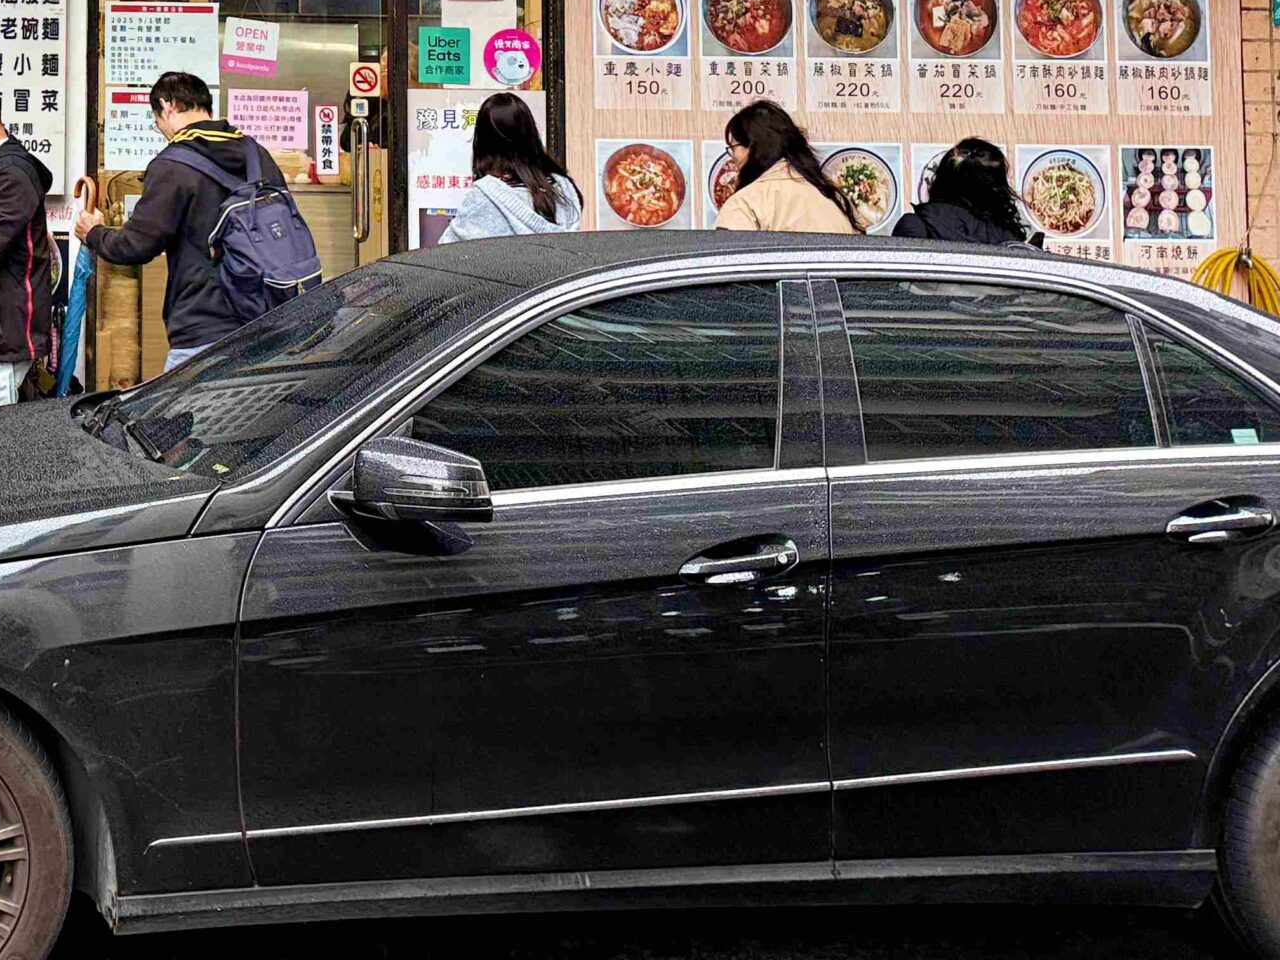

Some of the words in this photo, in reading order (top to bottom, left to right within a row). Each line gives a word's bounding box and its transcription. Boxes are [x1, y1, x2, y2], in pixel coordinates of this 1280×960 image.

[235, 26, 269, 40] OPEN
[236, 41, 265, 54] 營業中
[428, 36, 461, 48] Uber
[428, 50, 461, 61] Eats
[425, 65, 464, 75] 合作商家
[603, 62, 683, 78] 重慶小麵
[708, 62, 790, 77] 重慶冒菜鍋
[3, 123, 33, 136] 時間
[321, 124, 334, 170] 禁帶外食
[1141, 245, 1198, 260] 河南燒餅
